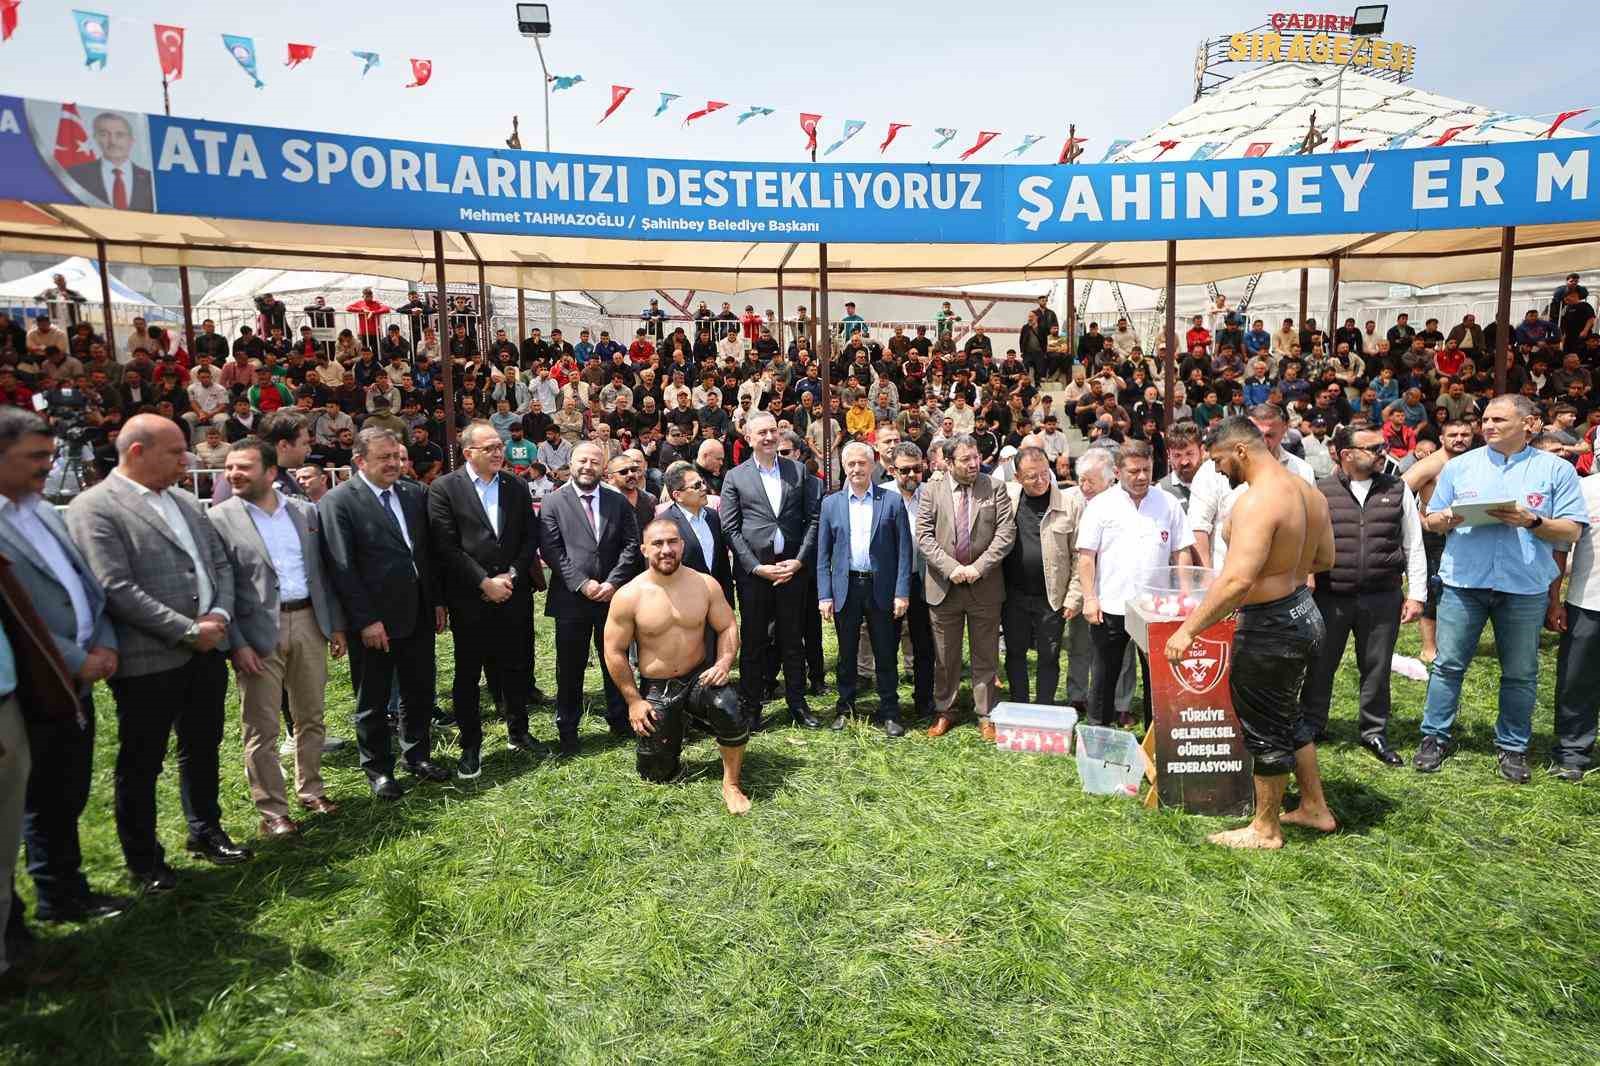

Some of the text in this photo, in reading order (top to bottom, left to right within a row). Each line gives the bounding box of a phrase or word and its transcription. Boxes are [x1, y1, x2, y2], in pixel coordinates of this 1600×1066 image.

[158, 126, 267, 179] ATA
[281, 139, 629, 203] SPORLARIMIZI
[1412, 157, 1505, 210] ER
[460, 208, 520, 223] Mehmet
[523, 211, 624, 227] TAHMAZOĞLU
[641, 217, 704, 232] Şahinbey
[708, 218, 765, 232] Belediye
[768, 219, 819, 232] Başkanı
[1180, 707, 1225, 722] TÜRKİYE
[1171, 727, 1235, 740] GELENEKSEL
[1177, 742, 1231, 757] GÜREŞLER
[1167, 760, 1242, 773] FEDERASYONU
